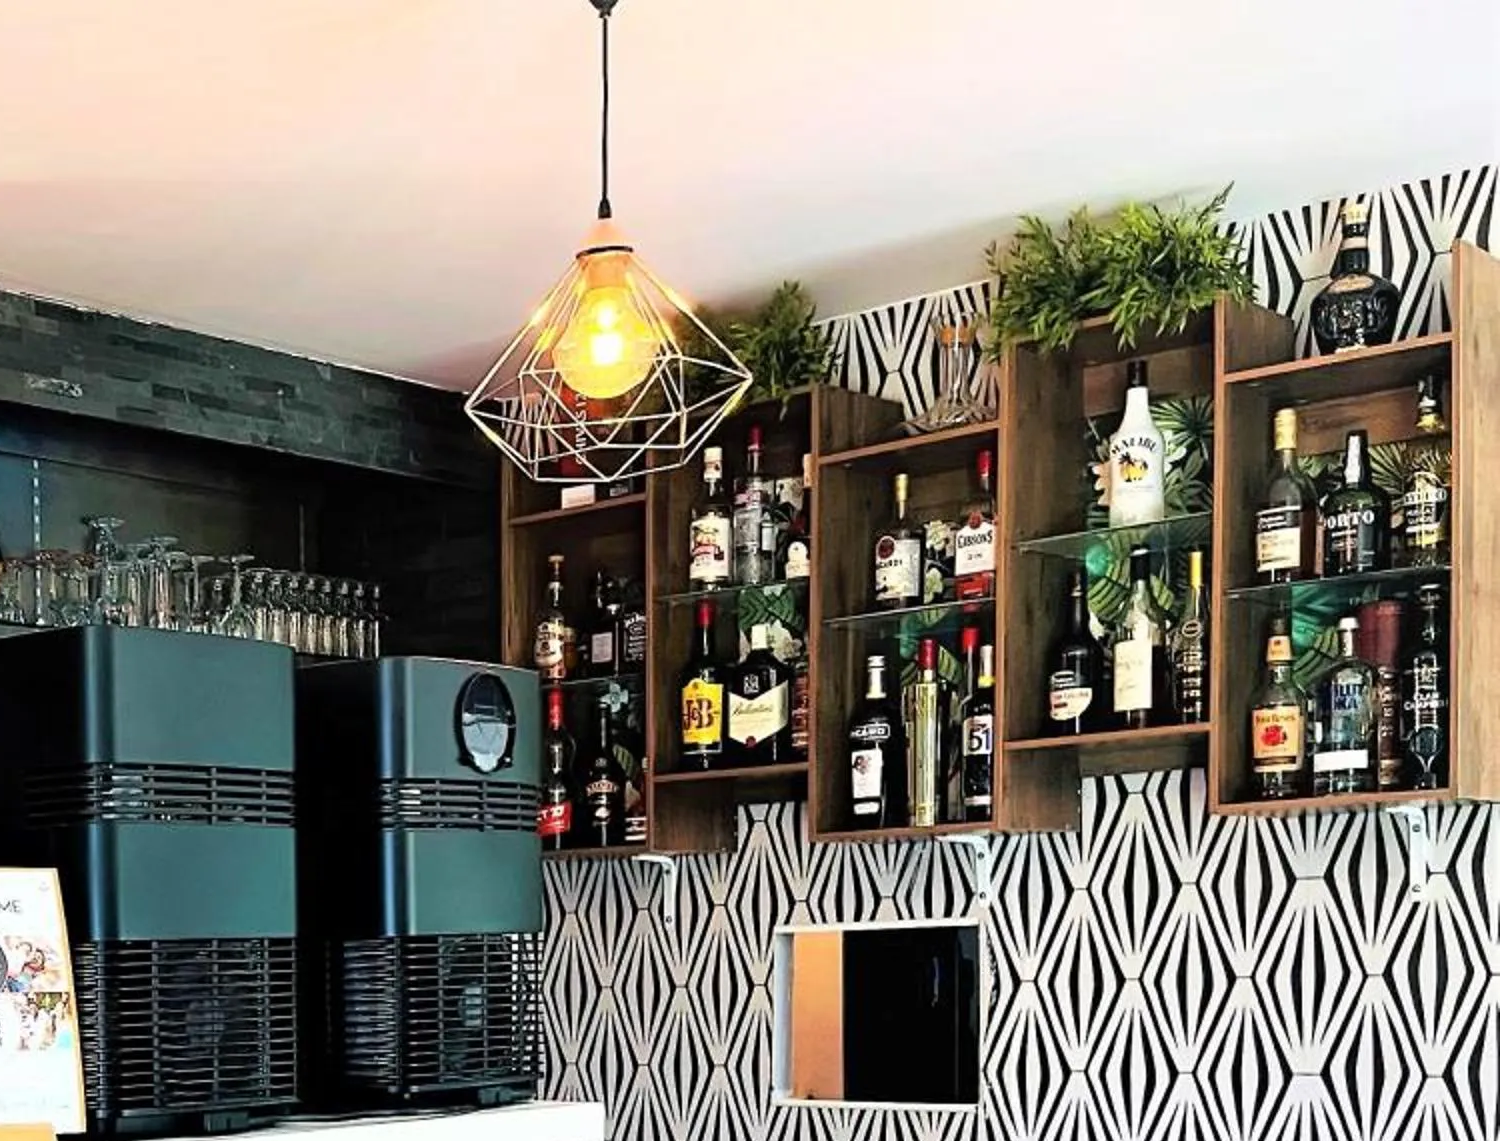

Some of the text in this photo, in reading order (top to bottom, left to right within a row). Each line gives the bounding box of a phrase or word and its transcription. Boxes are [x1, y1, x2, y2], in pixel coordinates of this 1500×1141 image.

[575, 410, 587, 465] CHIVS
[1324, 509, 1375, 529] ORTO
[968, 727, 992, 751] 51
